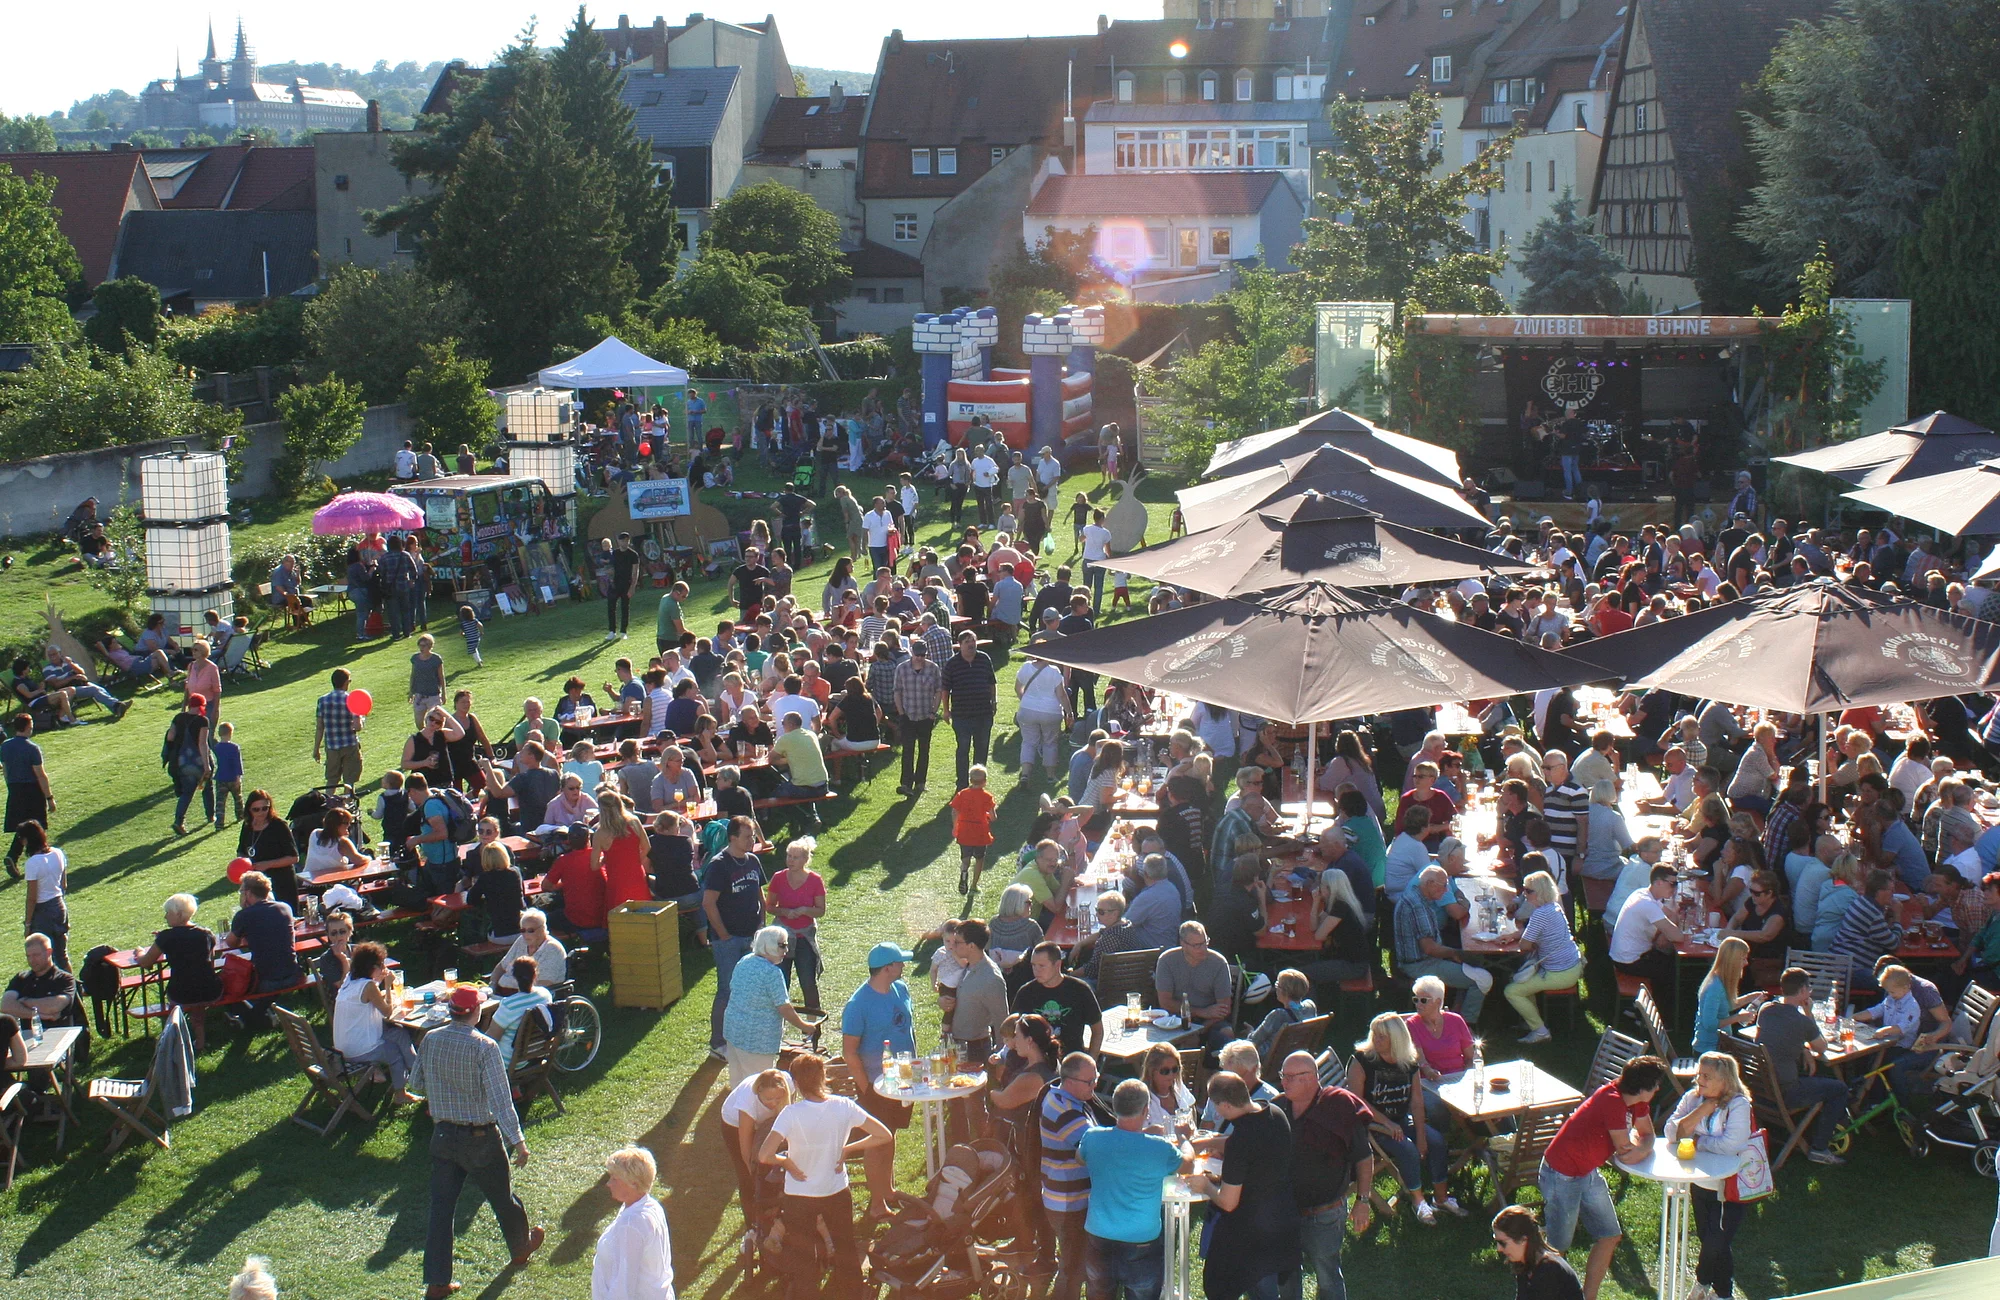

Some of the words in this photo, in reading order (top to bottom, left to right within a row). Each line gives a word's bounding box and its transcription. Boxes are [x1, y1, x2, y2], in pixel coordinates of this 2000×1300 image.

[1513, 318, 1585, 336] ZWIEBEL
[1400, 637, 1447, 658] Bräu
[1910, 632, 1960, 651] Bräu
[1162, 672, 1213, 685] ORIGINAL
[1670, 671, 1720, 684] ORIGINAL
[1914, 671, 1979, 688] BAMBERGER
[1402, 680, 1463, 697] BAMBERGER
